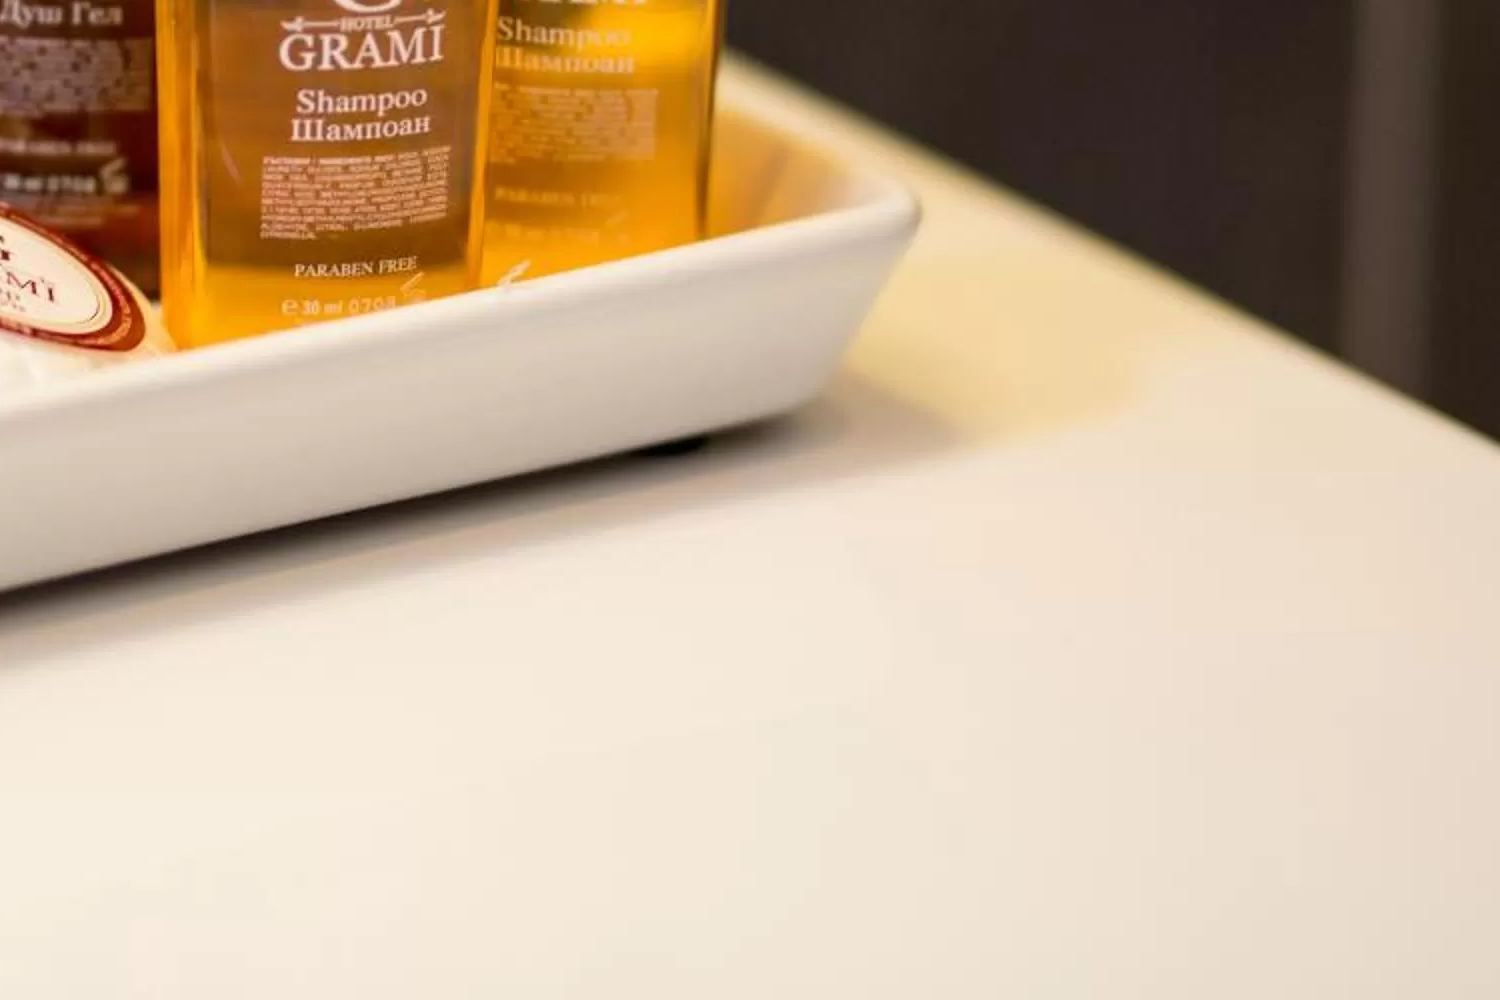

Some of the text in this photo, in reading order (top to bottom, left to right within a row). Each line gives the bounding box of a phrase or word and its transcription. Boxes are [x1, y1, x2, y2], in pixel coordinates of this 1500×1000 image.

[72, 0, 122, 26] Гел
[340, 15, 395, 31] HOTEL
[279, 23, 445, 71] GRAMI
[296, 87, 428, 117] Shampoo
[291, 114, 432, 142] Шампоан
[294, 255, 417, 277] PARABEN FREE
